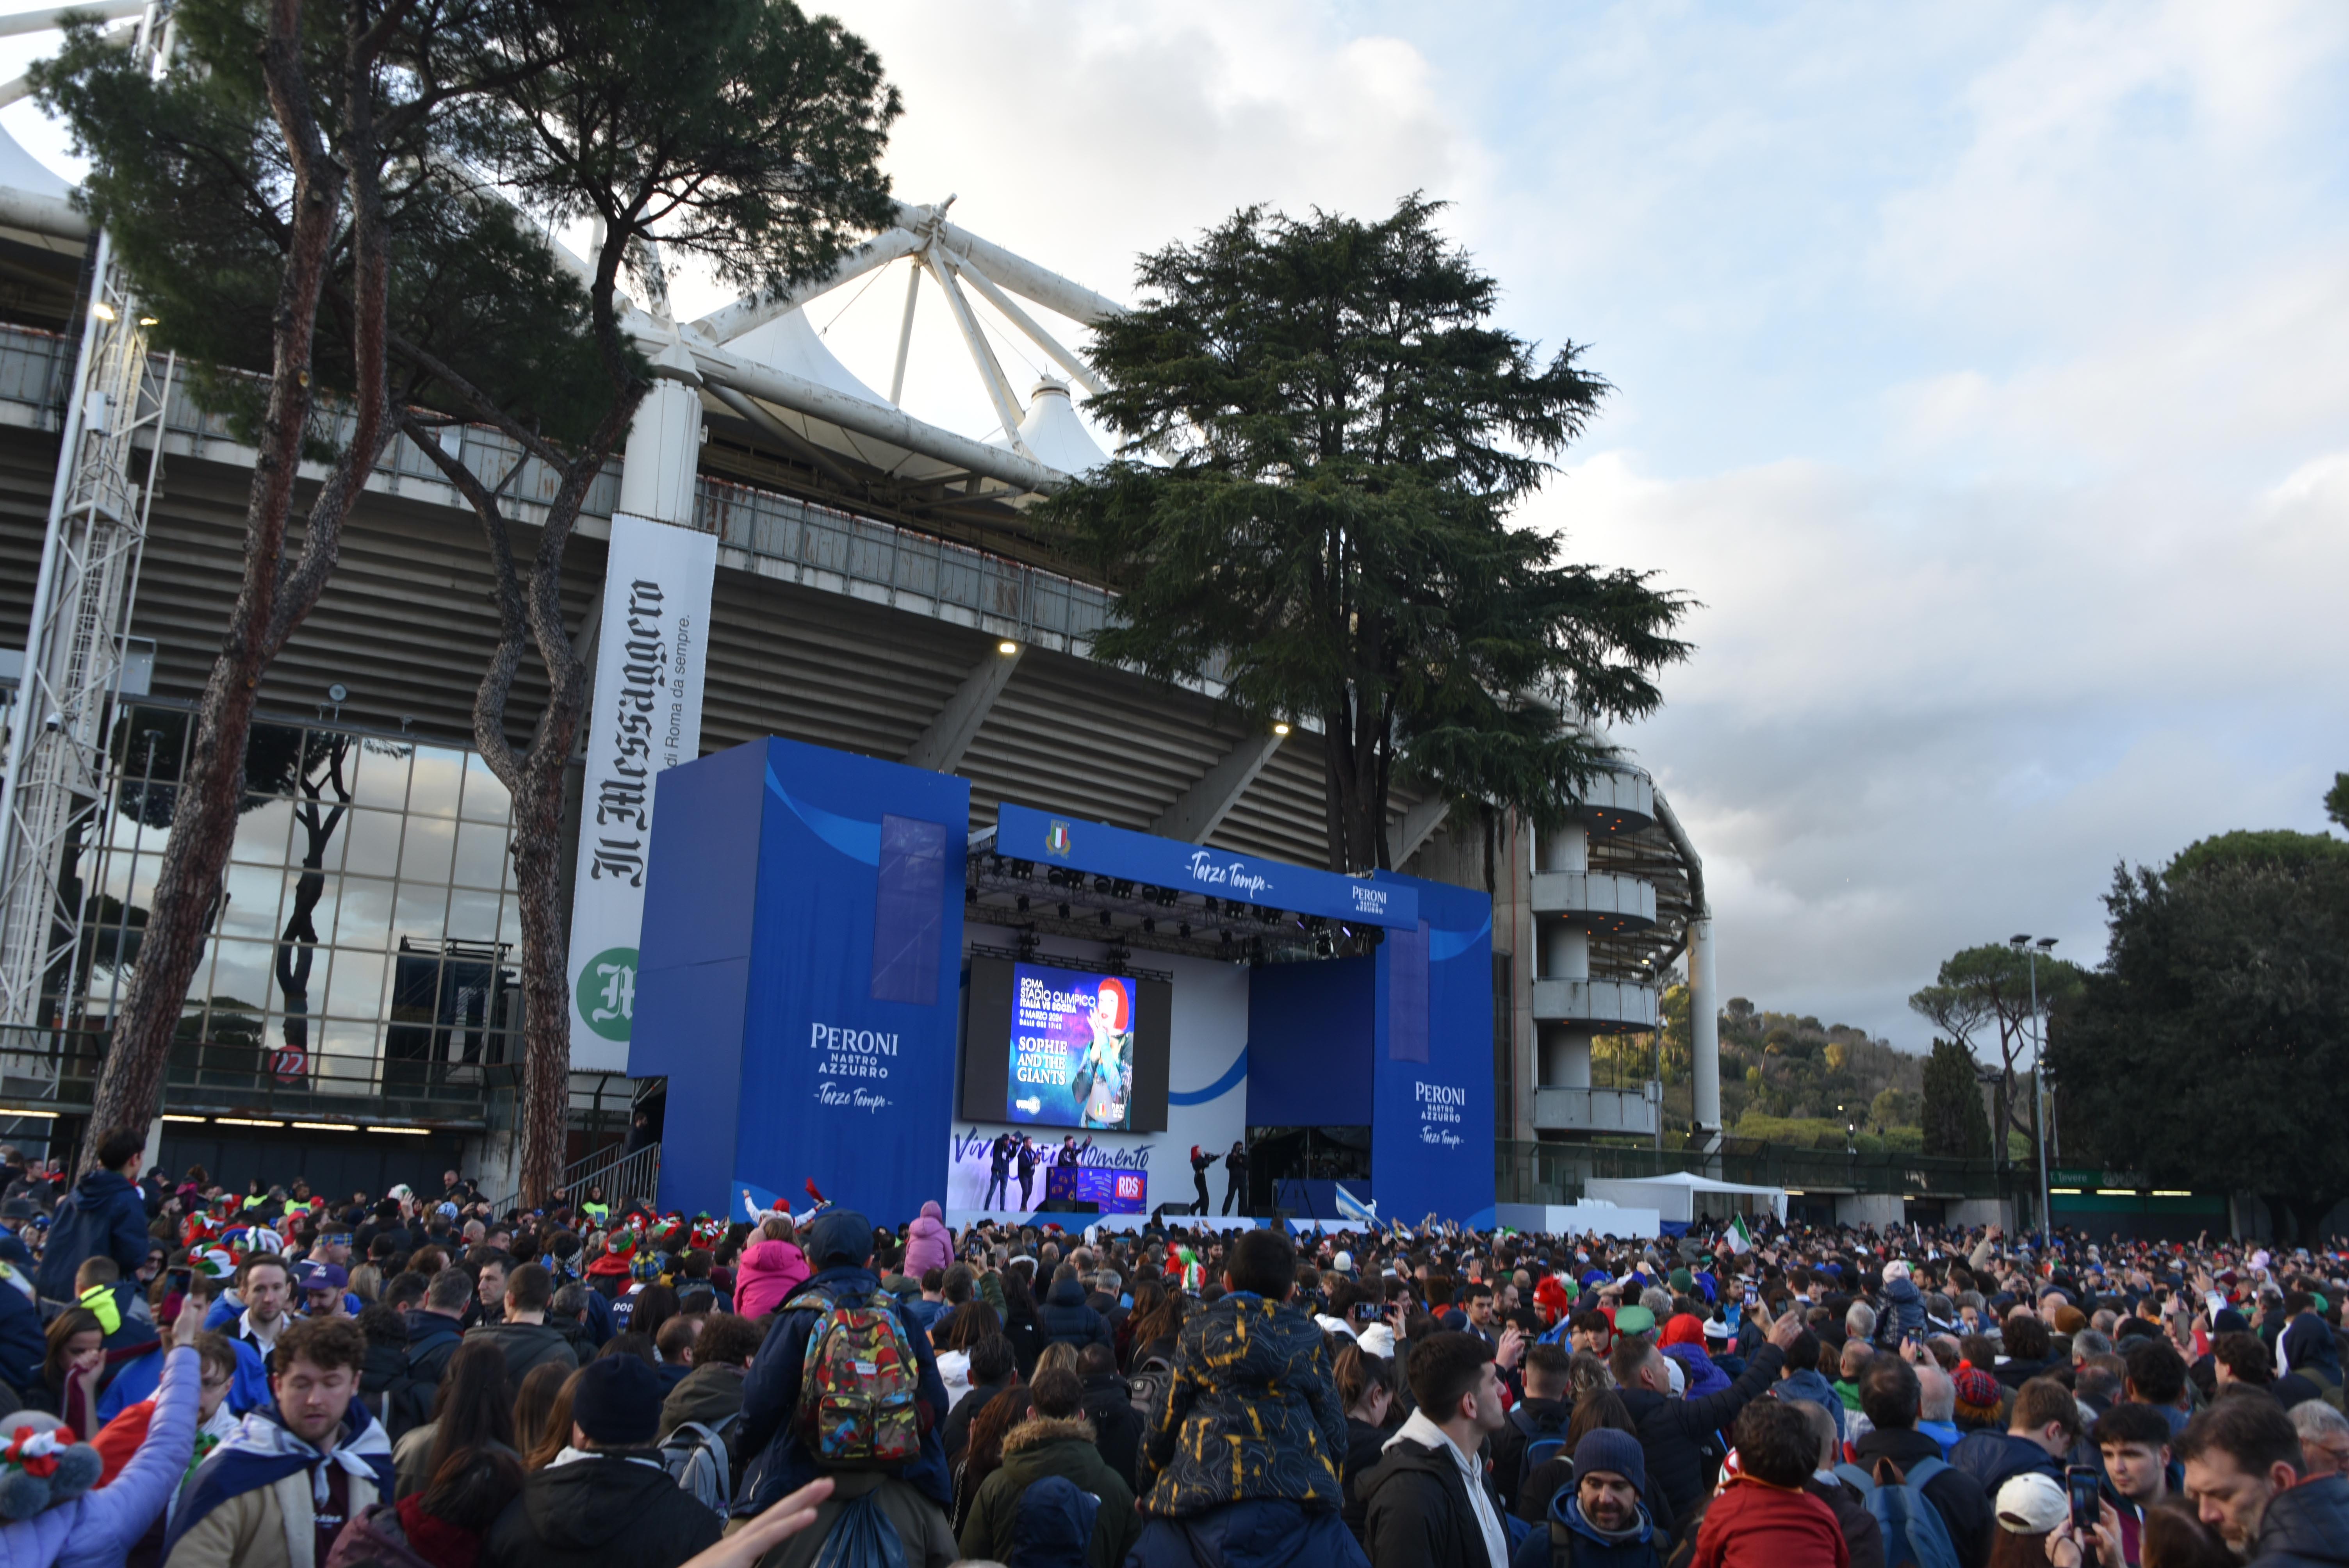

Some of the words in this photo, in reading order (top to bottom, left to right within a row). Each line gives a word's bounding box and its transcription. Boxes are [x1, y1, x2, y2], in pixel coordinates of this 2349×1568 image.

[675, 615, 691, 675] sempre.
[670, 679, 684, 698] da
[597, 577, 667, 831] Messaggero
[665, 703, 682, 748] Roma
[664, 753, 678, 768] di
[591, 837, 643, 887] Il
[1353, 885, 1387, 904] PERONI
[1021, 977, 1043, 989] ROMA
[1020, 987, 1051, 1002] STADIO
[1053, 991, 1096, 1007] OLIMPICO
[1020, 998, 1041, 1009] ITALIA
[1020, 1009, 1024, 1018] 9
[1025, 1010, 1048, 1021] MARZO
[1048, 1012, 1062, 1023] 2024
[811, 1022, 898, 1056] PERONI
[1019, 1036, 1068, 1056] SOPHIE
[275, 1051, 304, 1074] 22
[831, 1053, 877, 1066] NASTRO
[1018, 1053, 1042, 1067] AND
[1043, 1055, 1066, 1070] THE
[818, 1062, 888, 1079] AZZURRO
[1017, 1067, 1066, 1085] GIANTS
[1416, 1081, 1465, 1106] PERONI
[1421, 1111, 1460, 1123] AZZURRO
[1428, 1103, 1454, 1113] NASTRO
[1119, 1176, 1138, 1195] RDS
[2058, 1171, 2087, 1183] Tevere
